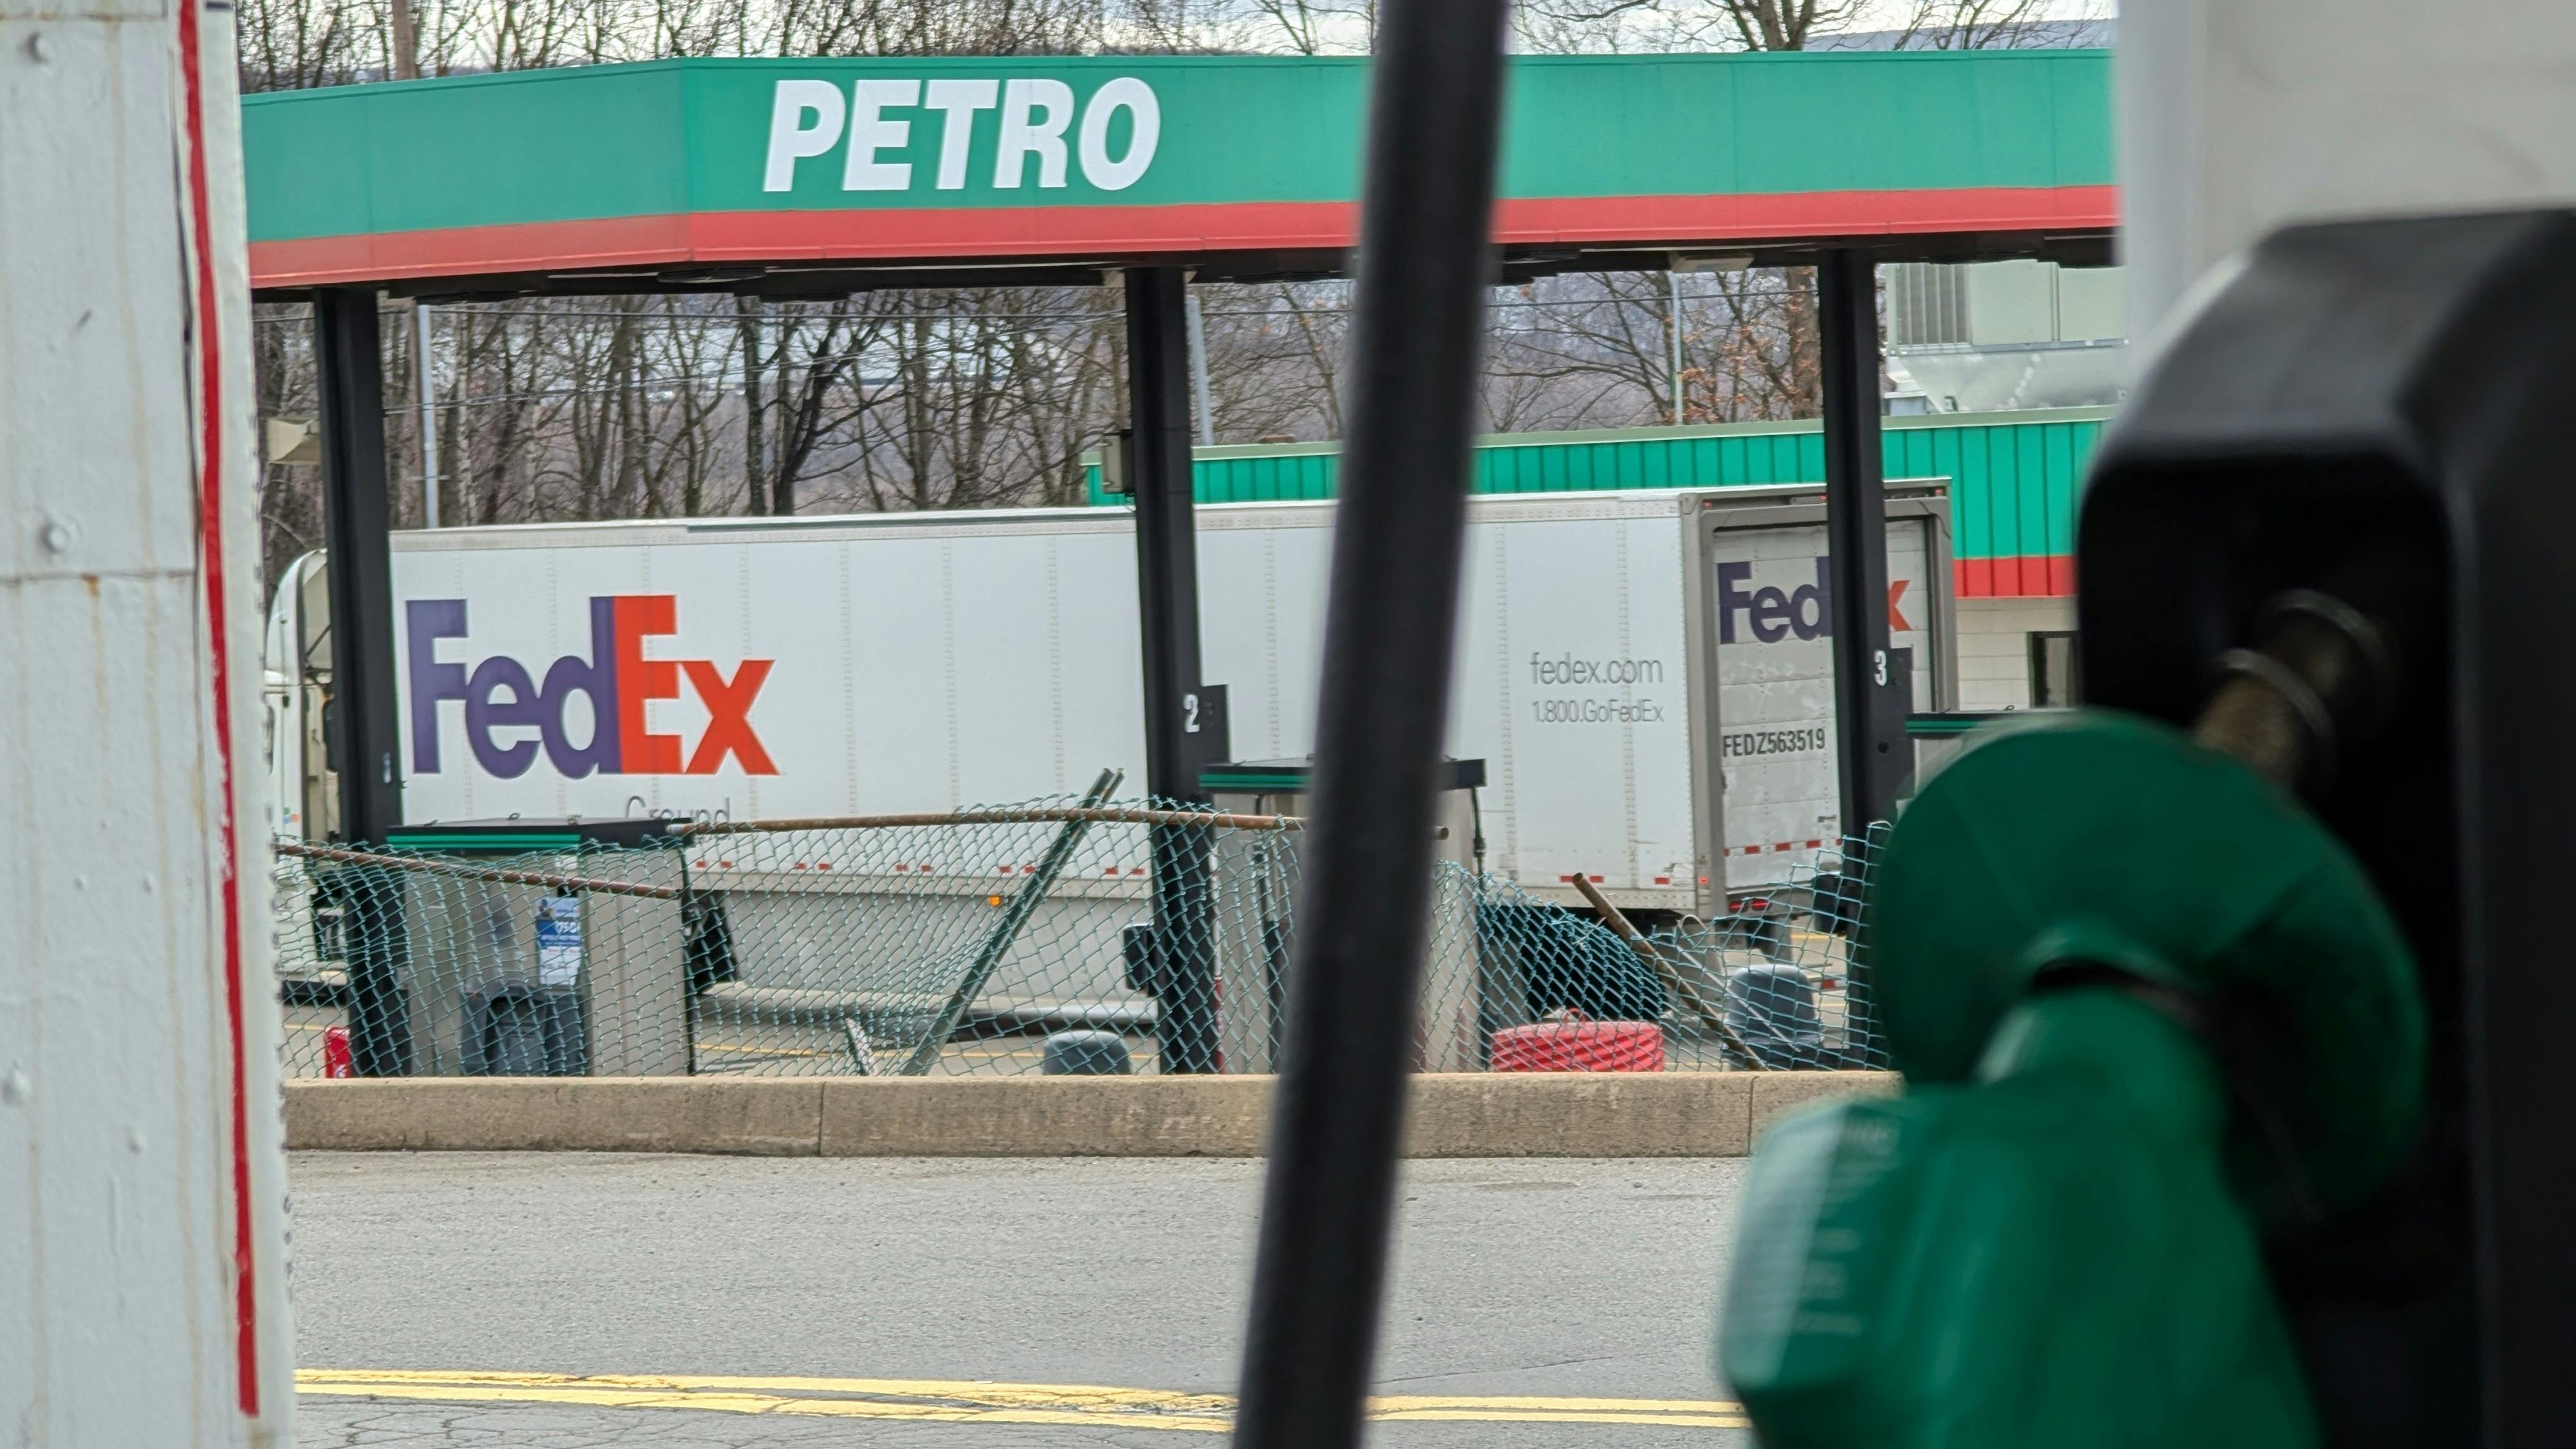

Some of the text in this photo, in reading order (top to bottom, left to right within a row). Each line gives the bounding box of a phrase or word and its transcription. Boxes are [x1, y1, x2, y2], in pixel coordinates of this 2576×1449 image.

[763, 77, 1160, 191] PETRO
[1717, 556, 1912, 644] Fedx
[406, 595, 780, 779] FedEx
[1529, 652, 1664, 684] fedex.com
[1873, 650, 1887, 686] 3
[1183, 694, 1200, 732] 2
[1722, 728, 1826, 758] FEDZ563519
